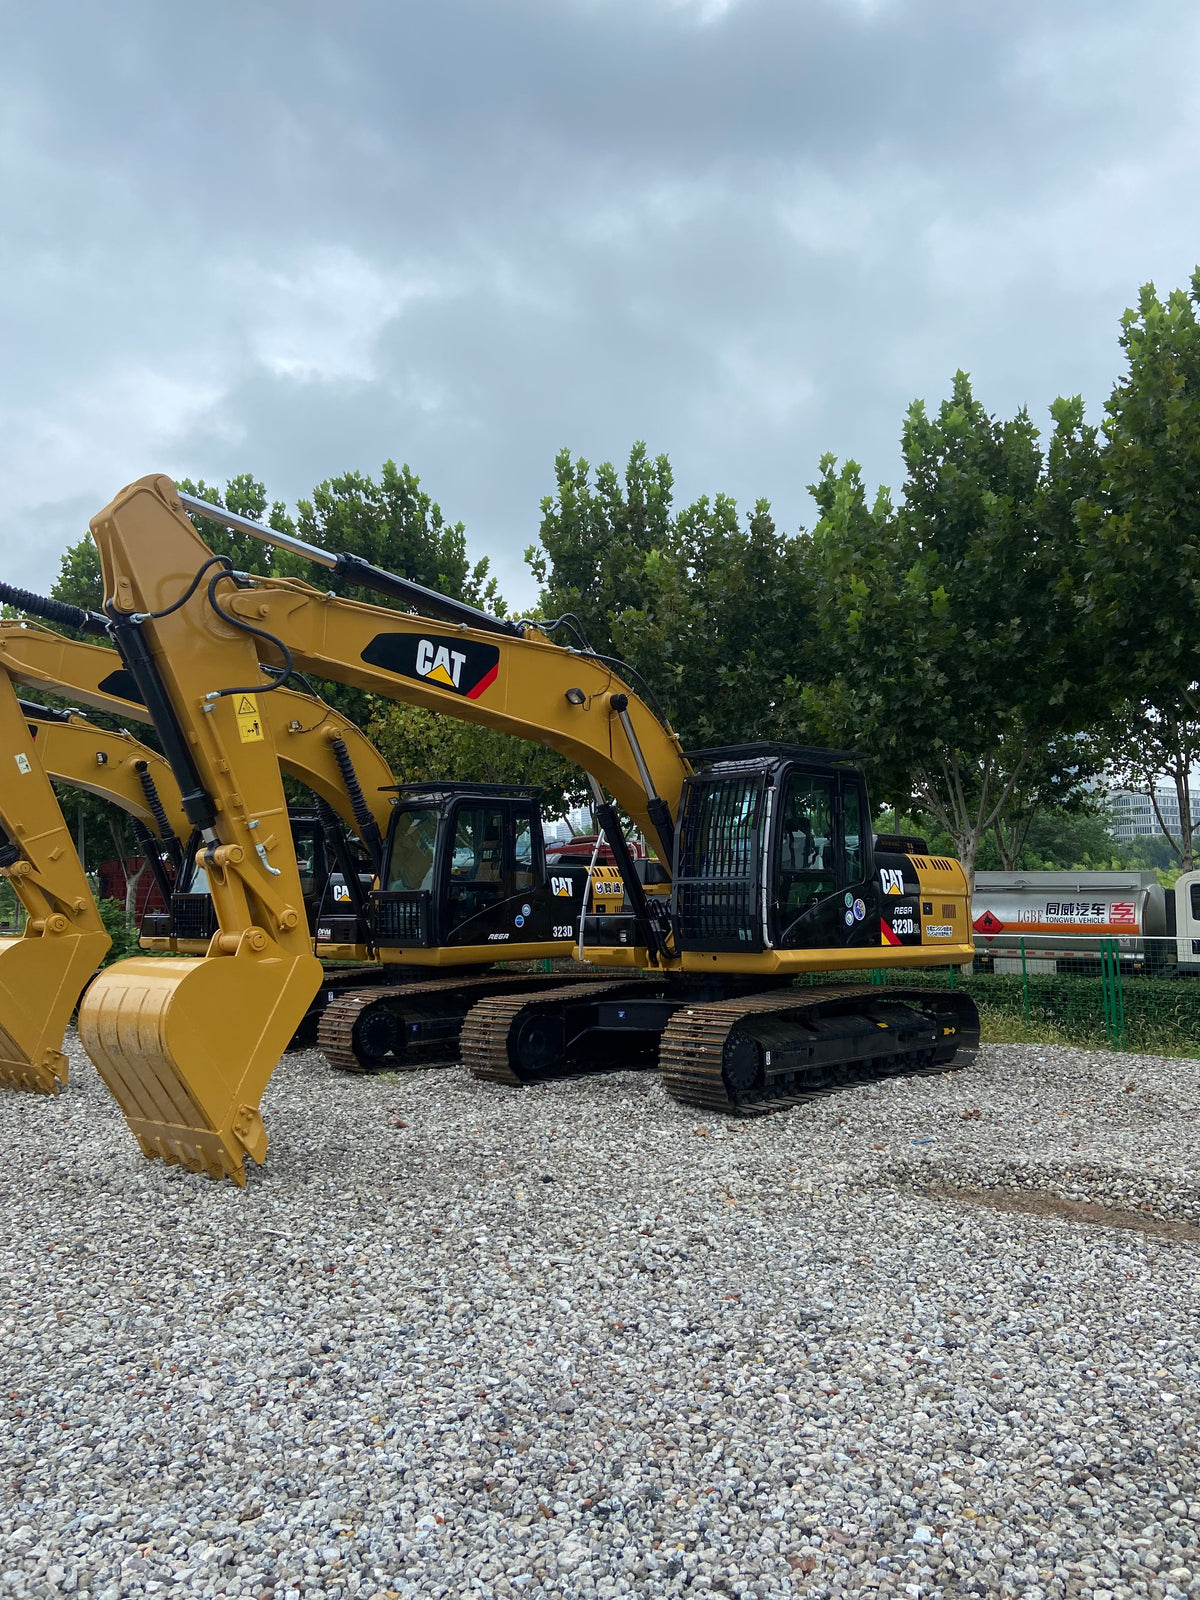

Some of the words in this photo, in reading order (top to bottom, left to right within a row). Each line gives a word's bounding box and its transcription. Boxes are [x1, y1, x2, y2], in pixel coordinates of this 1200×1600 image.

[415, 639, 466, 688] CAT
[551, 876, 573, 897] CAT
[880, 868, 905, 895] CAT
[1045, 902, 1106, 916] 同威汽车
[552, 925, 573, 938] 323D
[892, 919, 914, 934] 323D
